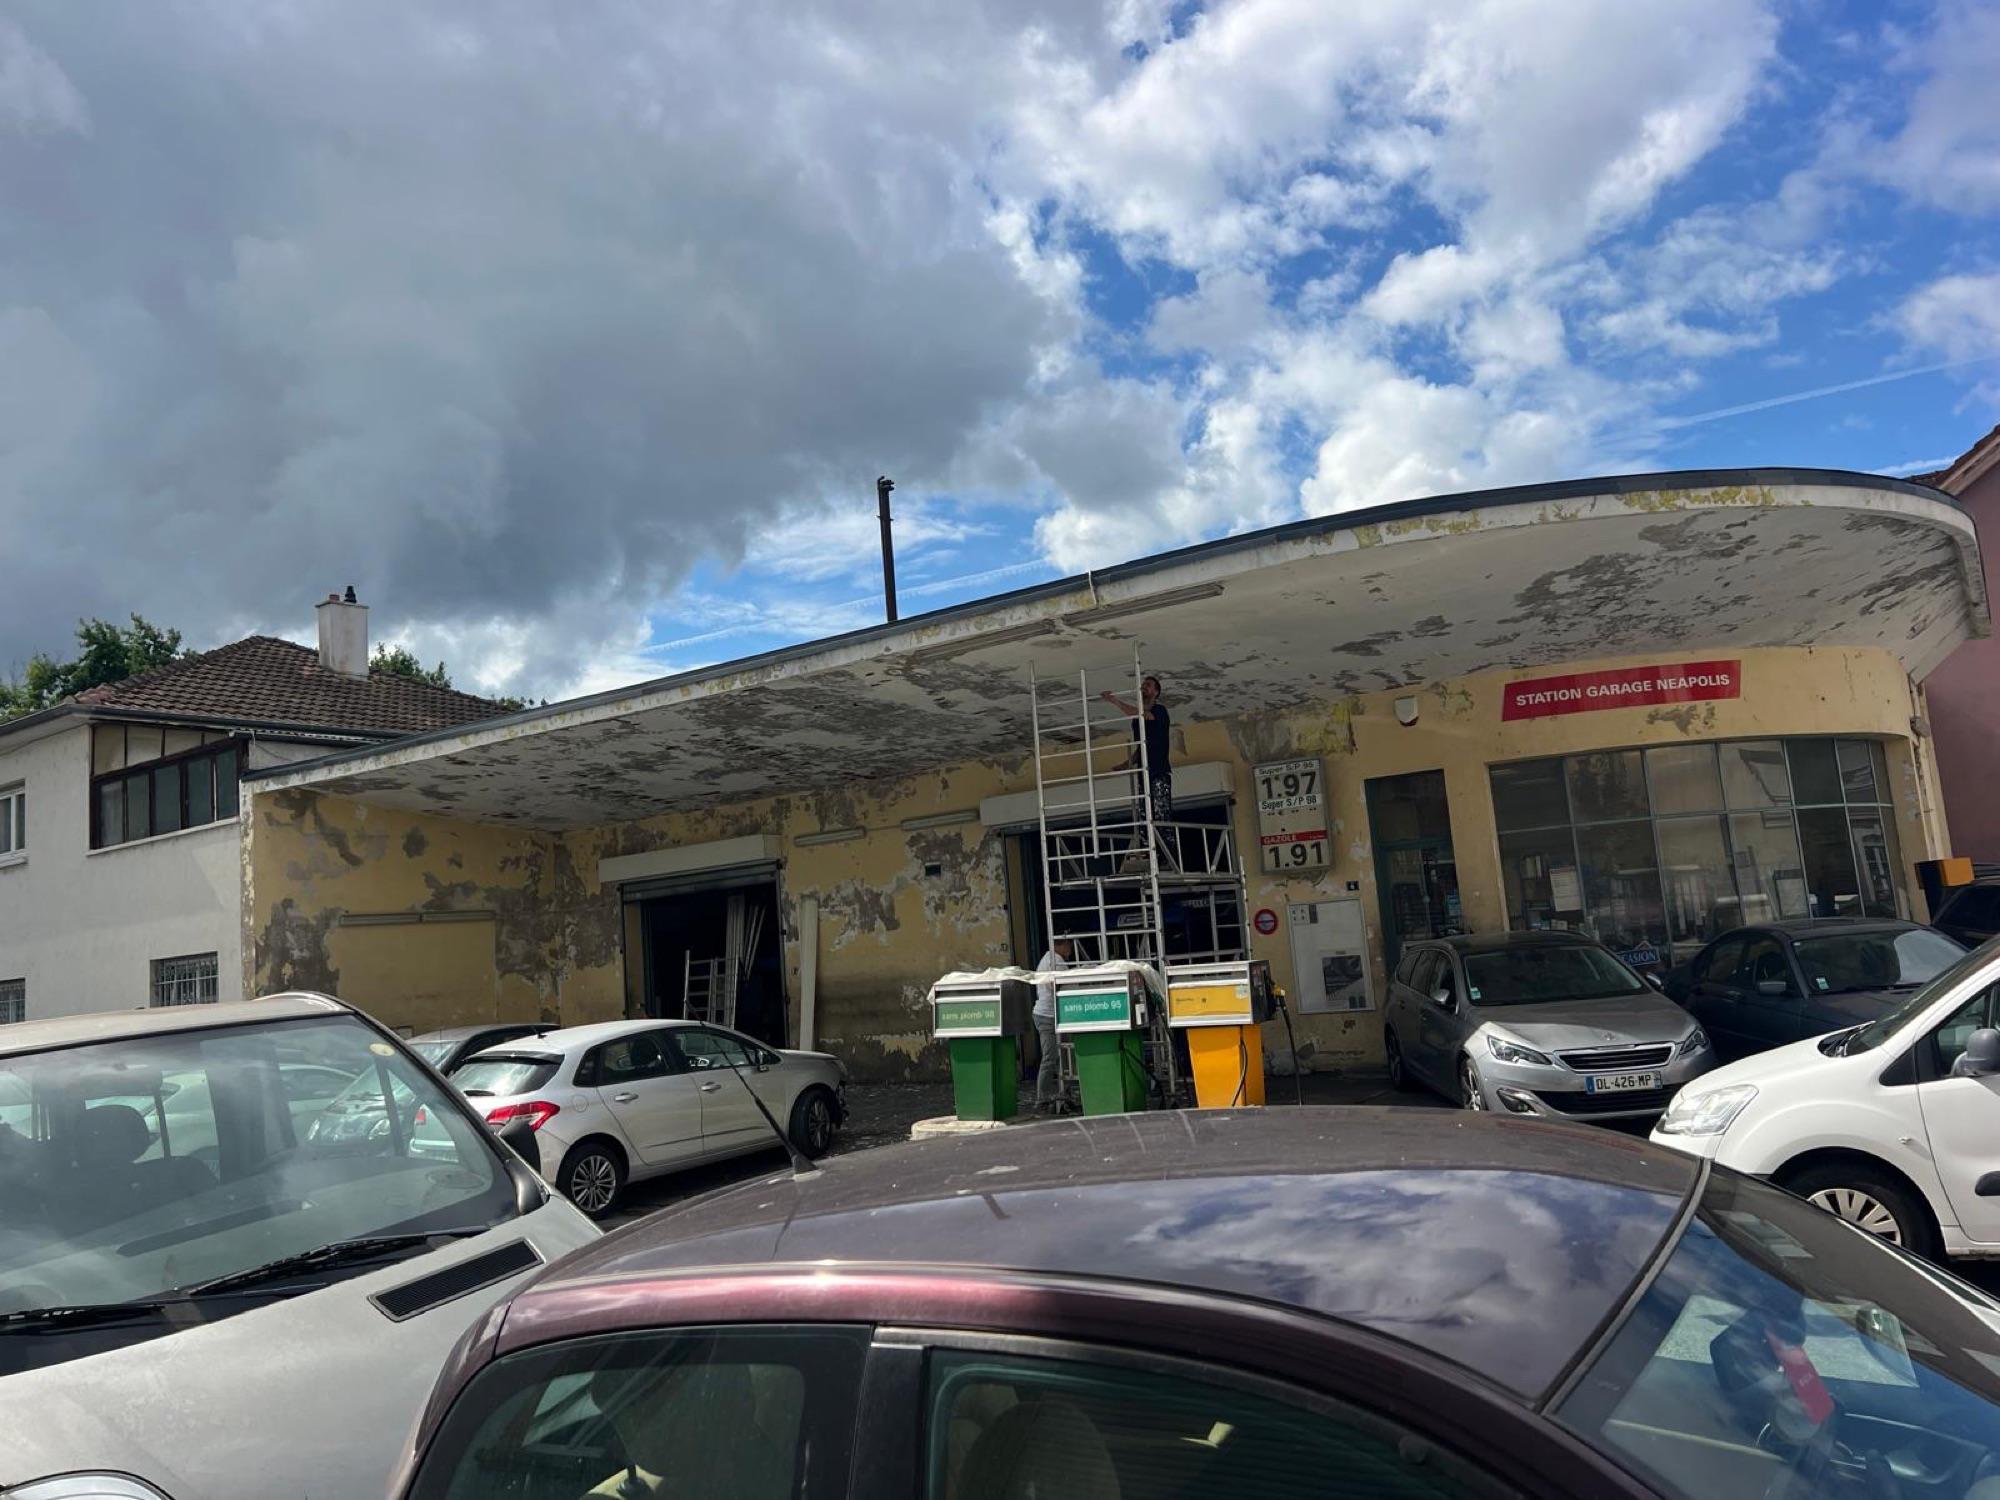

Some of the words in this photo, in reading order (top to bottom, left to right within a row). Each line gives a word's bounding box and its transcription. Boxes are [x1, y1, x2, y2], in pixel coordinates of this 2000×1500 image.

[1516, 688, 1582, 706] STATION
[1586, 680, 1652, 697] GARAGE
[1656, 674, 1730, 690] NEAPOLIS
[1262, 771, 1316, 799] 1.97
[1261, 800, 1284, 810] Super
[1263, 834, 1297, 845] GAZOLE
[1269, 842, 1323, 868] 1.91
[1064, 1003, 1083, 1012] sans
[1084, 1001, 1110, 1013] plomb
[1110, 999, 1122, 1010] 95
[1595, 1074, 1652, 1090] DL-426-MP
